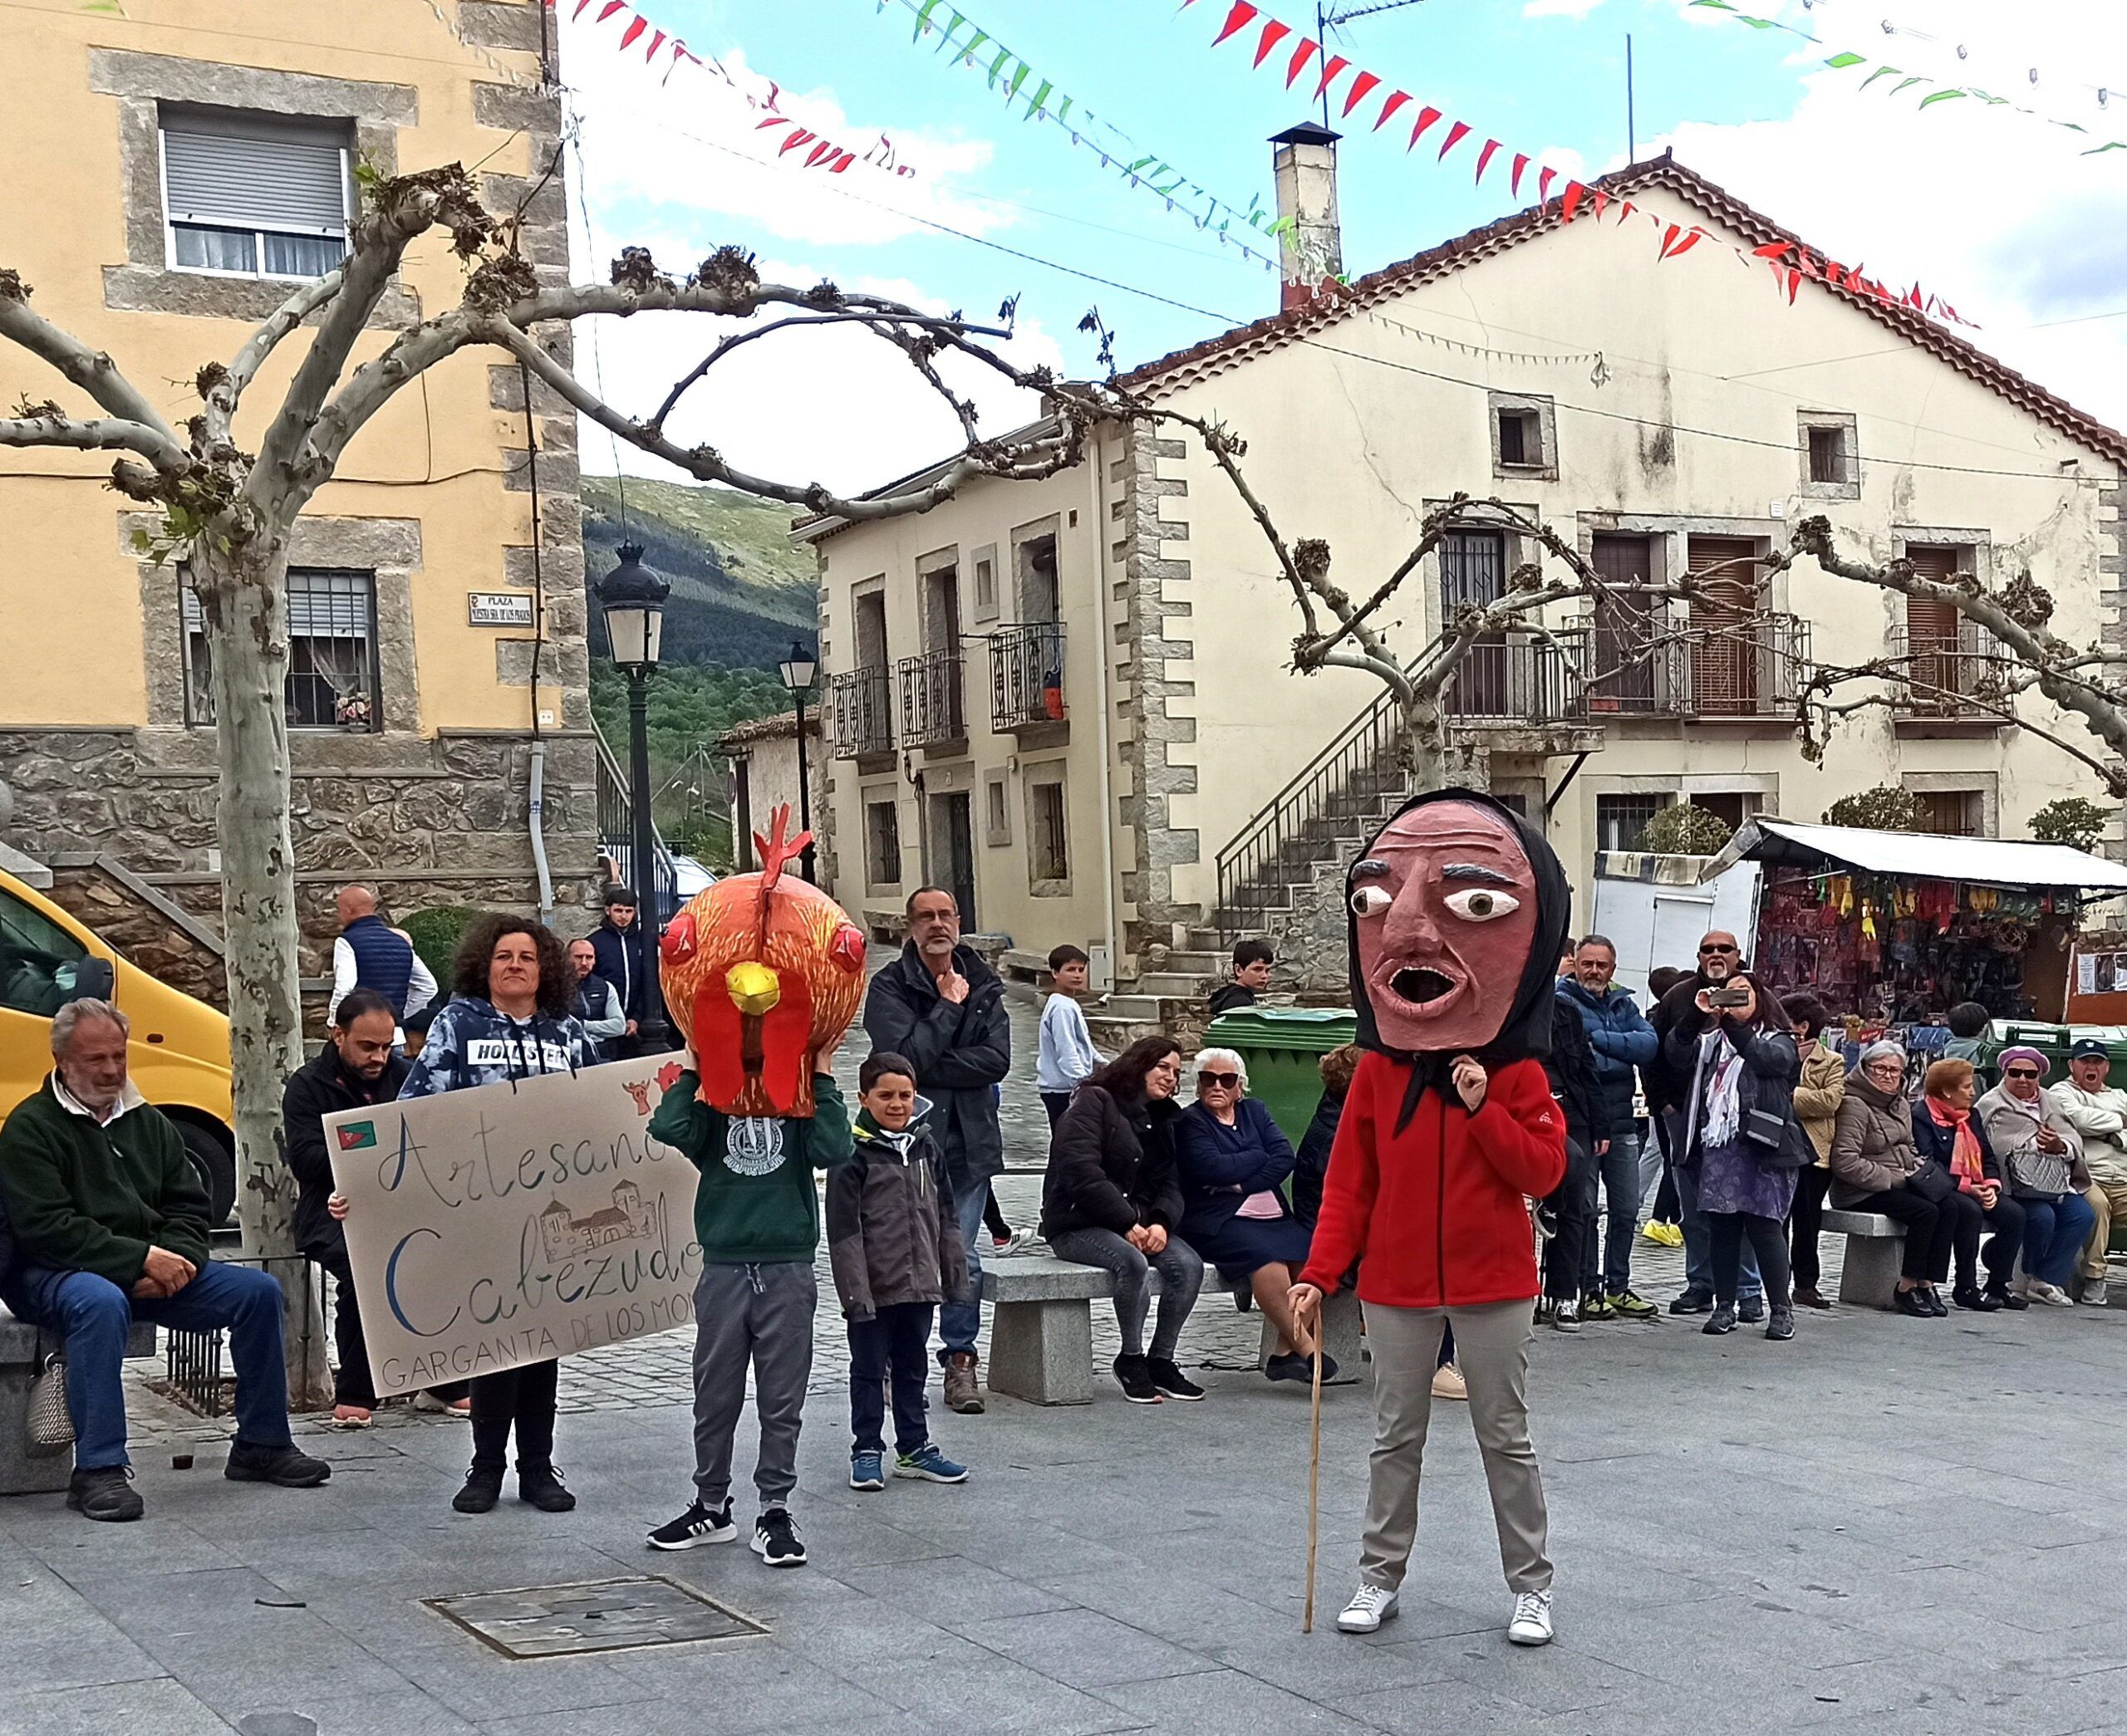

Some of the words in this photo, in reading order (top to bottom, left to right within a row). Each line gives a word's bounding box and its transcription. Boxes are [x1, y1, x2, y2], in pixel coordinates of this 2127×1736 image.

[488, 597, 513, 606] PLAZA
[499, 610, 506, 620] DE
[477, 1045, 565, 1064] HOLLSER
[378, 1111, 686, 1207] Artesano
[382, 1327, 559, 1388] GARGANTA
[571, 1315, 598, 1349] DE
[606, 1302, 645, 1341] LOS
